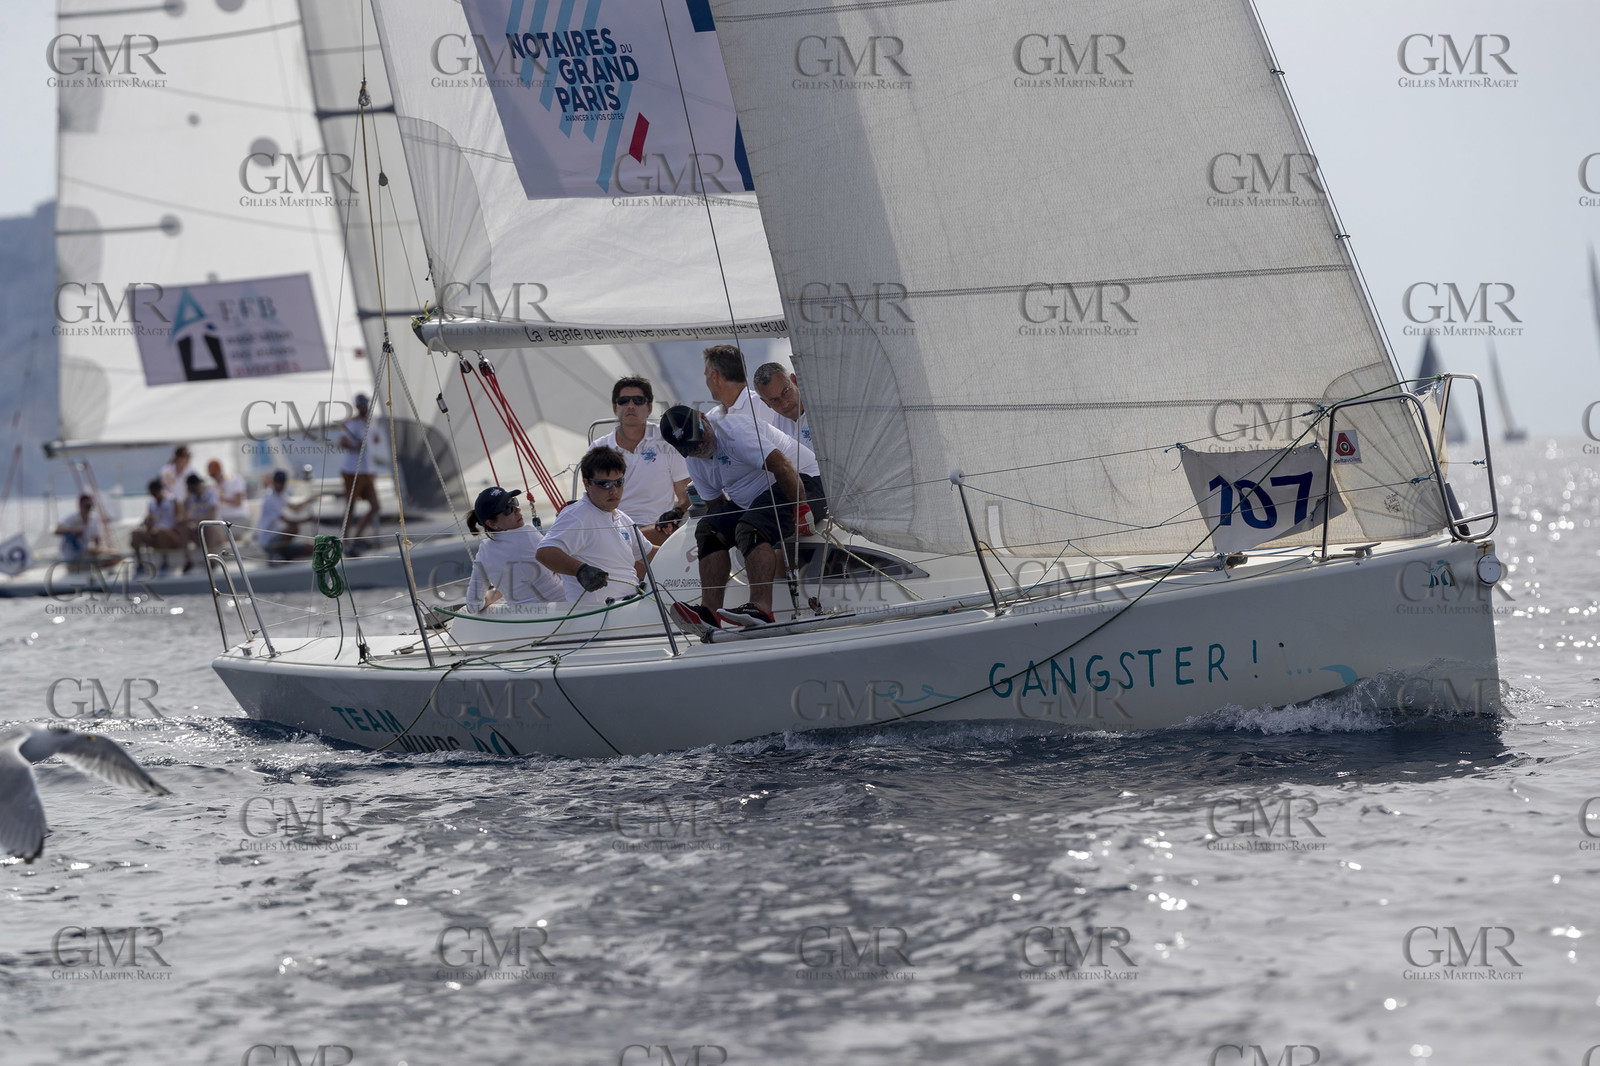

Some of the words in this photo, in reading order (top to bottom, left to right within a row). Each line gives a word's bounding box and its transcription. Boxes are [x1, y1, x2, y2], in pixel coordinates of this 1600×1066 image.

[505, 28, 618, 59] NOTAIRES
[620, 43, 633, 54] DU
[558, 55, 640, 85] GRAND
[555, 84, 621, 113] PARIS
[524, 326, 544, 342] La
[1208, 470, 1314, 530] 107
[680, 578, 702, 588] SURPRIS
[988, 642, 1229, 699] GANGSTER
[1252, 639, 1259, 679] !
[330, 706, 406, 734] TEAM
